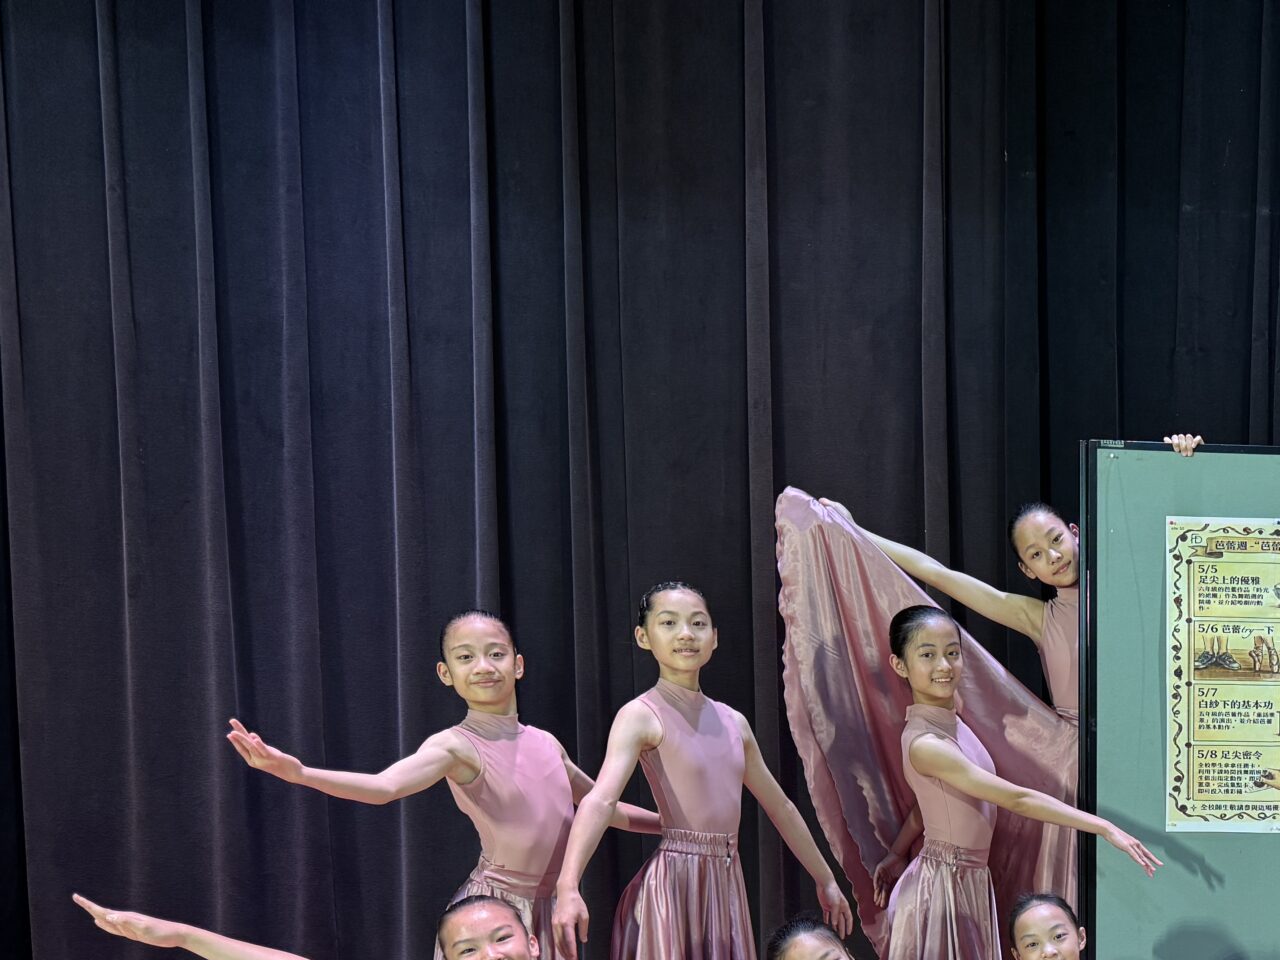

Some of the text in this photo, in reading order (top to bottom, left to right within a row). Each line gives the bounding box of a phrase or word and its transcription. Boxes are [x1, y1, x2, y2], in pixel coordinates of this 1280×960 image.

[1198, 564, 1218, 575] 5/5
[1198, 576, 1260, 586] 足尖上的優雅
[1198, 623, 1218, 634] 5/6
[1198, 687, 1218, 697] 5/7
[1198, 699, 1273, 710] 白紗下的基本功
[1197, 749, 1218, 760] 5/8
